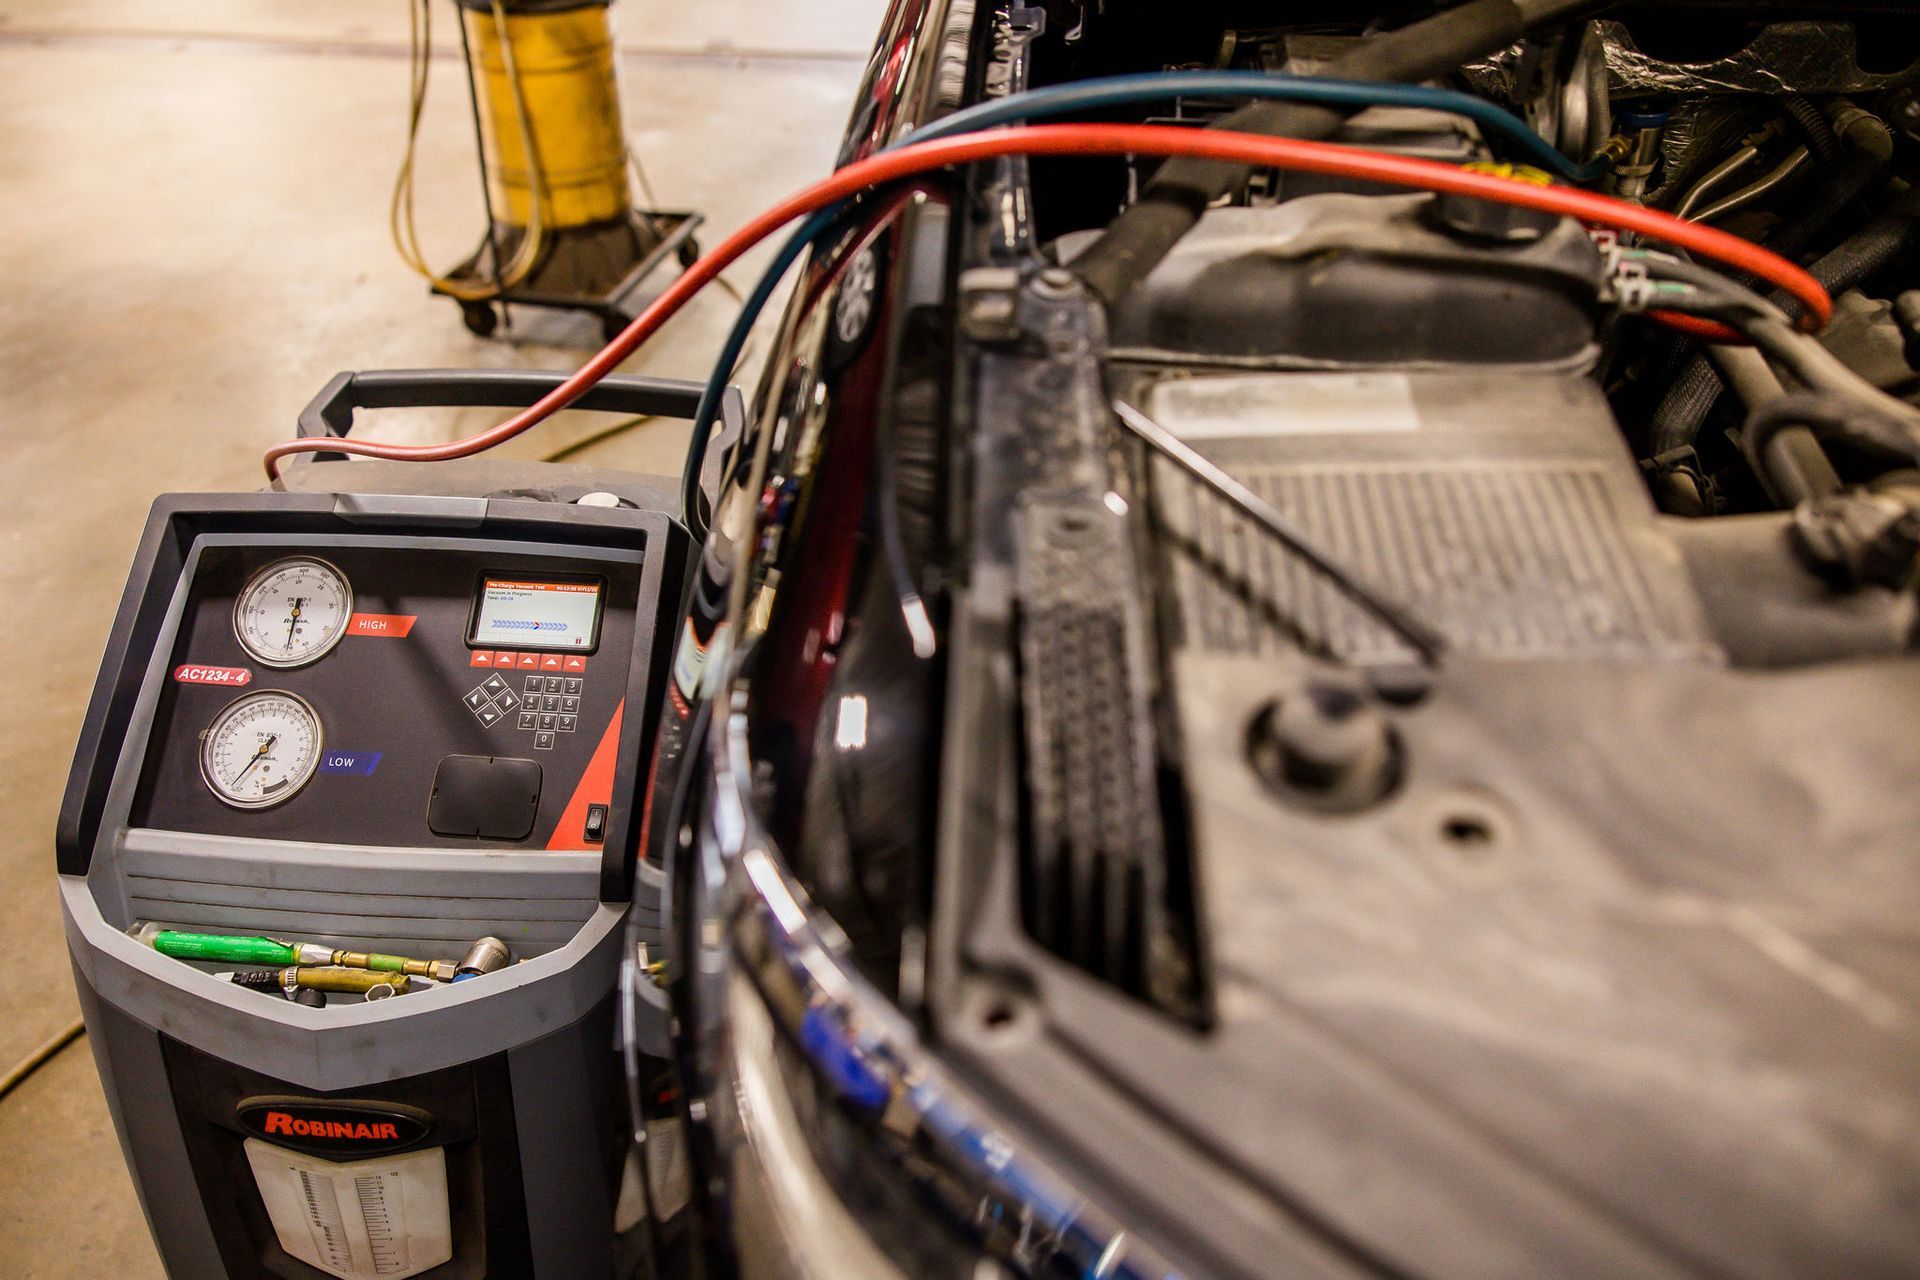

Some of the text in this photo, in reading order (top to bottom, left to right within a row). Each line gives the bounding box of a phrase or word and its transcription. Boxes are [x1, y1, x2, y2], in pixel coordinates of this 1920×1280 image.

[359, 620, 387, 630] HIGH
[178, 668, 246, 683] AC1234-4
[532, 679, 536, 687] 1
[550, 680, 556, 688] 2
[570, 681, 576, 689] 3
[525, 715, 531, 723] 7
[544, 716, 550, 724] 8
[564, 717, 570, 725] 9
[328, 757, 355, 767] LOW
[264, 1111, 398, 1139] ROBINAIR
